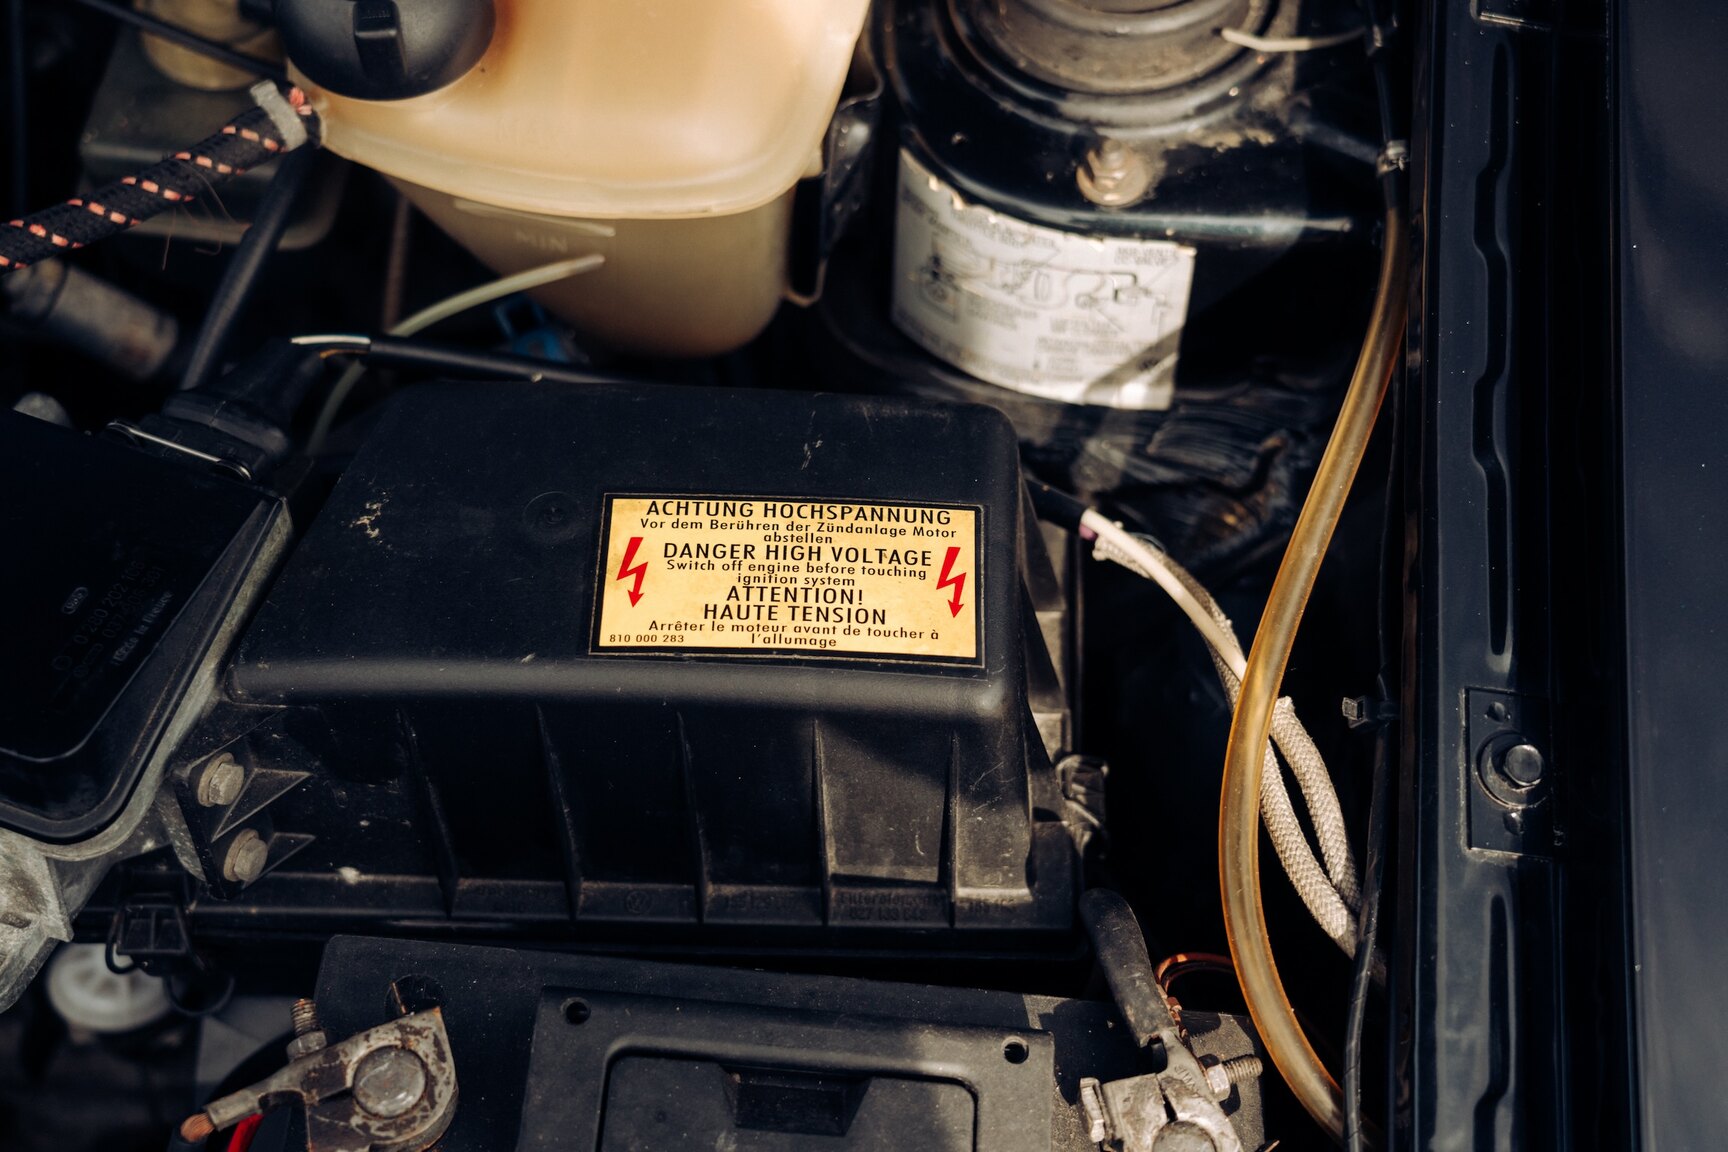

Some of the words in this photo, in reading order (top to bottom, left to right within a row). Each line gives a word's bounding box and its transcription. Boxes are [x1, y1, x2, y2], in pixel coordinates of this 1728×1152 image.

[514, 230, 568, 253] MIN
[647, 501, 753, 518] ACHTUNG
[764, 503, 951, 525] HOCHSPANNUNG
[641, 519, 665, 529] Vor
[671, 520, 703, 530] dem
[710, 519, 780, 531] Berühren
[786, 522, 810, 532] der
[817, 522, 906, 537] Zündanlage
[913, 527, 956, 538] Motor
[764, 533, 832, 544] abstellen
[664, 543, 755, 560] DANGER
[766, 546, 821, 562] HIGH
[832, 547, 931, 566] VOLTAGE
[667, 560, 715, 571] Switch
[722, 560, 742, 571] off
[749, 563, 800, 576] engine
[807, 562, 855, 574] before
[862, 565, 926, 579] touching
[737, 573, 798, 585] ignition
[804, 576, 855, 587] system
[727, 586, 863, 605] ATTENTION!
[704, 604, 778, 621] HAUTE
[788, 606, 885, 625] TENSION
[610, 635, 631, 643] 810
[636, 635, 658, 643] 000
[663, 635, 684, 643] 283
[649, 620, 705, 632] Arrêter
[711, 621, 725, 632] le
[731, 624, 787, 633] moteur
[794, 625, 837, 635] avant
[843, 625, 860, 636] de
[867, 625, 924, 638] toucher
[931, 628, 938, 639] à
